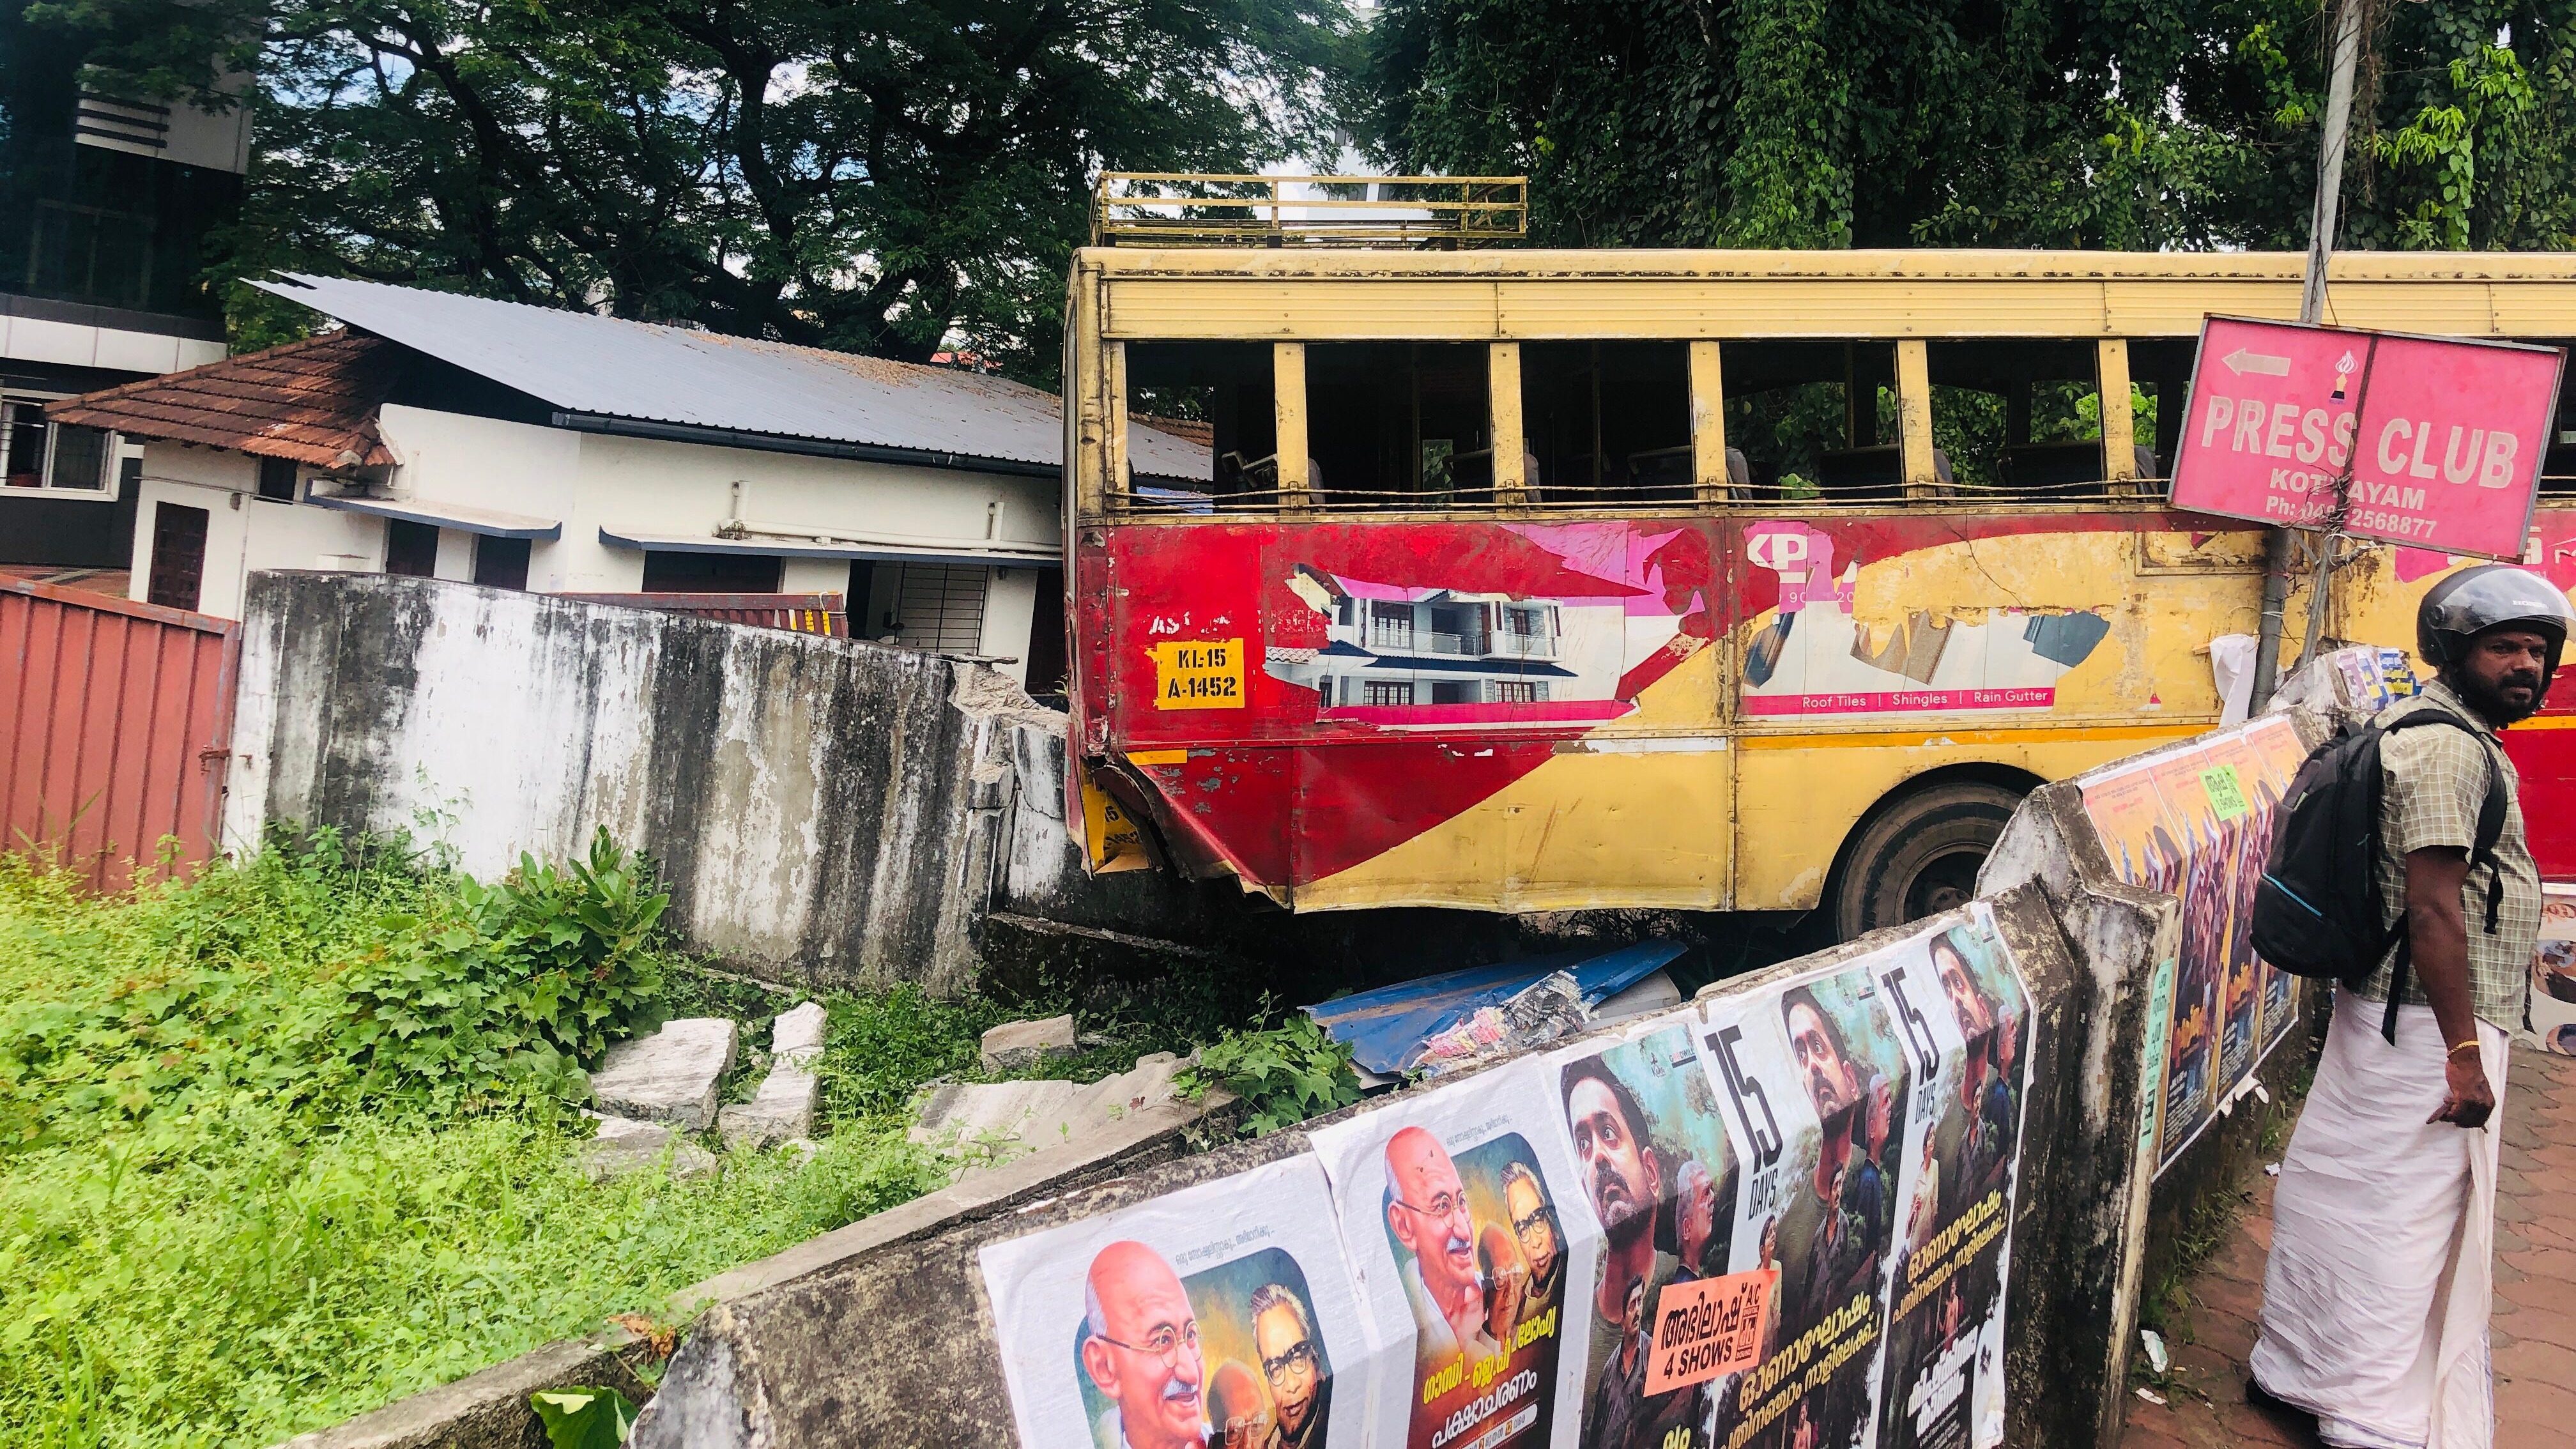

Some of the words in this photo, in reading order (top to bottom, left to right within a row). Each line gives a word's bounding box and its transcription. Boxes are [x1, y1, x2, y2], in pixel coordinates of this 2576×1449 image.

[2202, 395, 2358, 466] PRESS
[2377, 418, 2518, 489] CLUB
[2266, 496, 2296, 516] Ph:
[2301, 500, 2437, 539] 048-2568877
[1178, 648, 1226, 668] KL-15
[1167, 677, 1237, 698] A-1452
[1802, 696, 1833, 709] Roof
[1837, 695, 1867, 707] Tiles
[1892, 693, 1948, 709] Shingles
[1974, 691, 2002, 703] Rain
[2005, 690, 2048, 702] Gutter
[1880, 966, 1940, 1086] 15
[1704, 1024, 1783, 1175] 15
[1915, 1082, 1936, 1125] DAYS
[1748, 1167, 1779, 1222] DAYS
[1661, 1282, 1748, 1351] അഭിലാഷ്
[1745, 1282, 1761, 1307] A/C
[1423, 1351, 1464, 1405] ഗാന്ധി
[1663, 1352, 1675, 1380] 4
[1678, 1335, 1733, 1377] SHOWS
[1432, 1368, 1538, 1449] പക്ഷാചരണം
